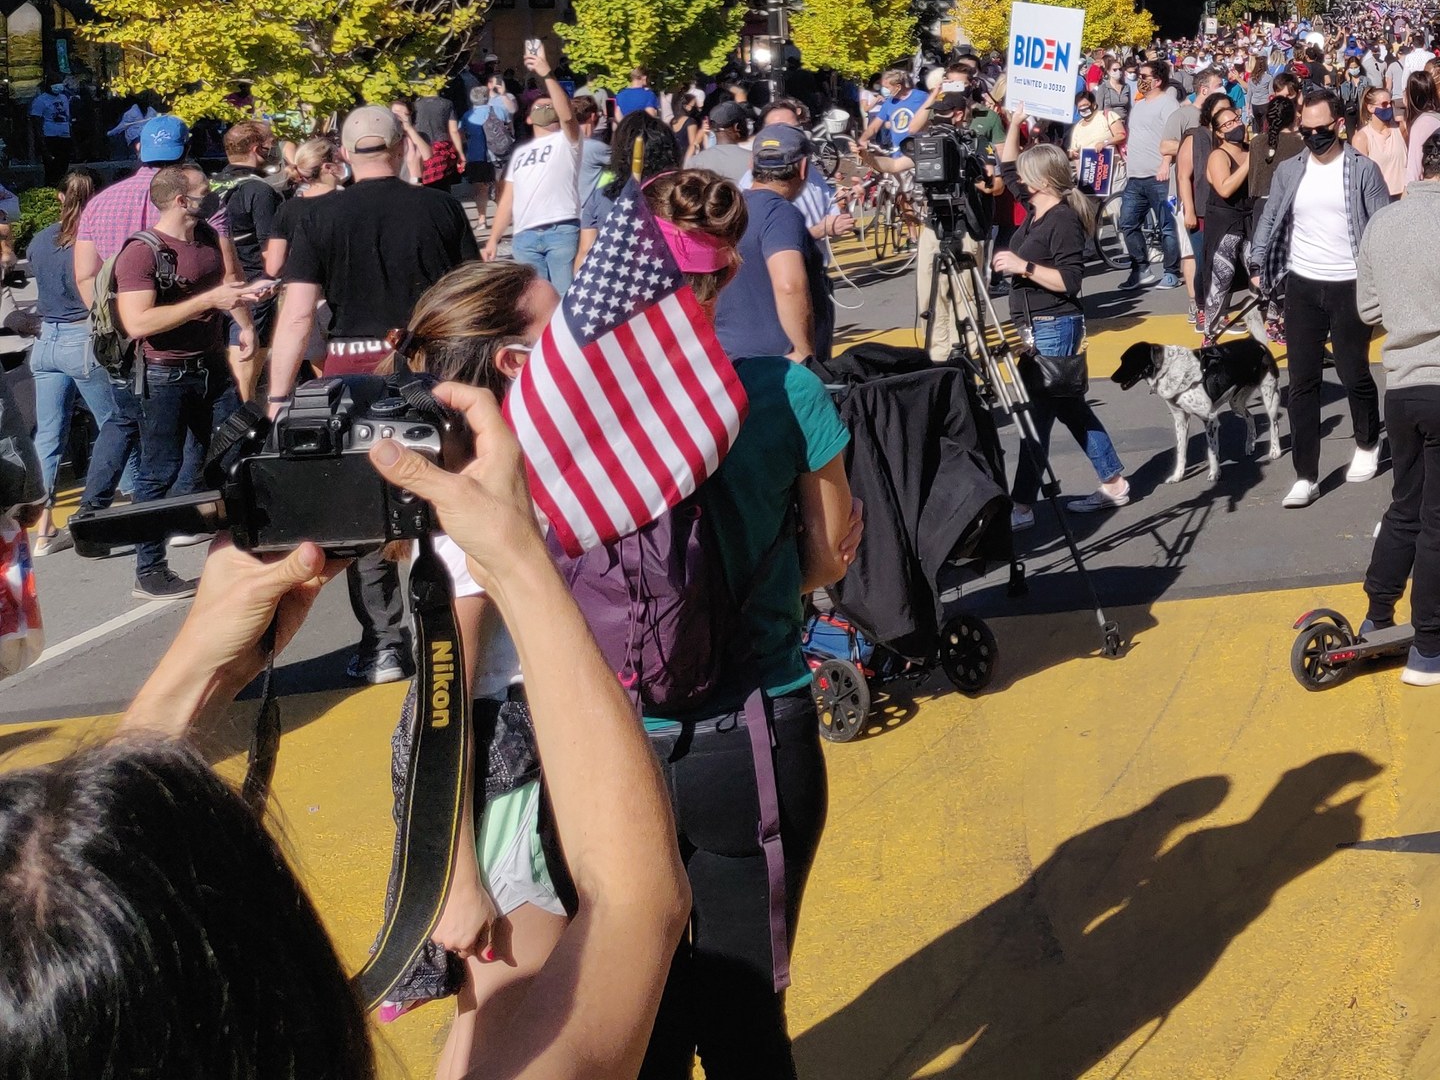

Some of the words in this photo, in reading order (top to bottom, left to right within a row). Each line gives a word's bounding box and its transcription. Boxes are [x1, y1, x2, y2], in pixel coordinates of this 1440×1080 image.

[1013, 34, 1072, 74] BIDEN
[1023, 78, 1042, 89] UNITED
[1048, 82, 1067, 93] 30330
[431, 640, 455, 728] Nikon
